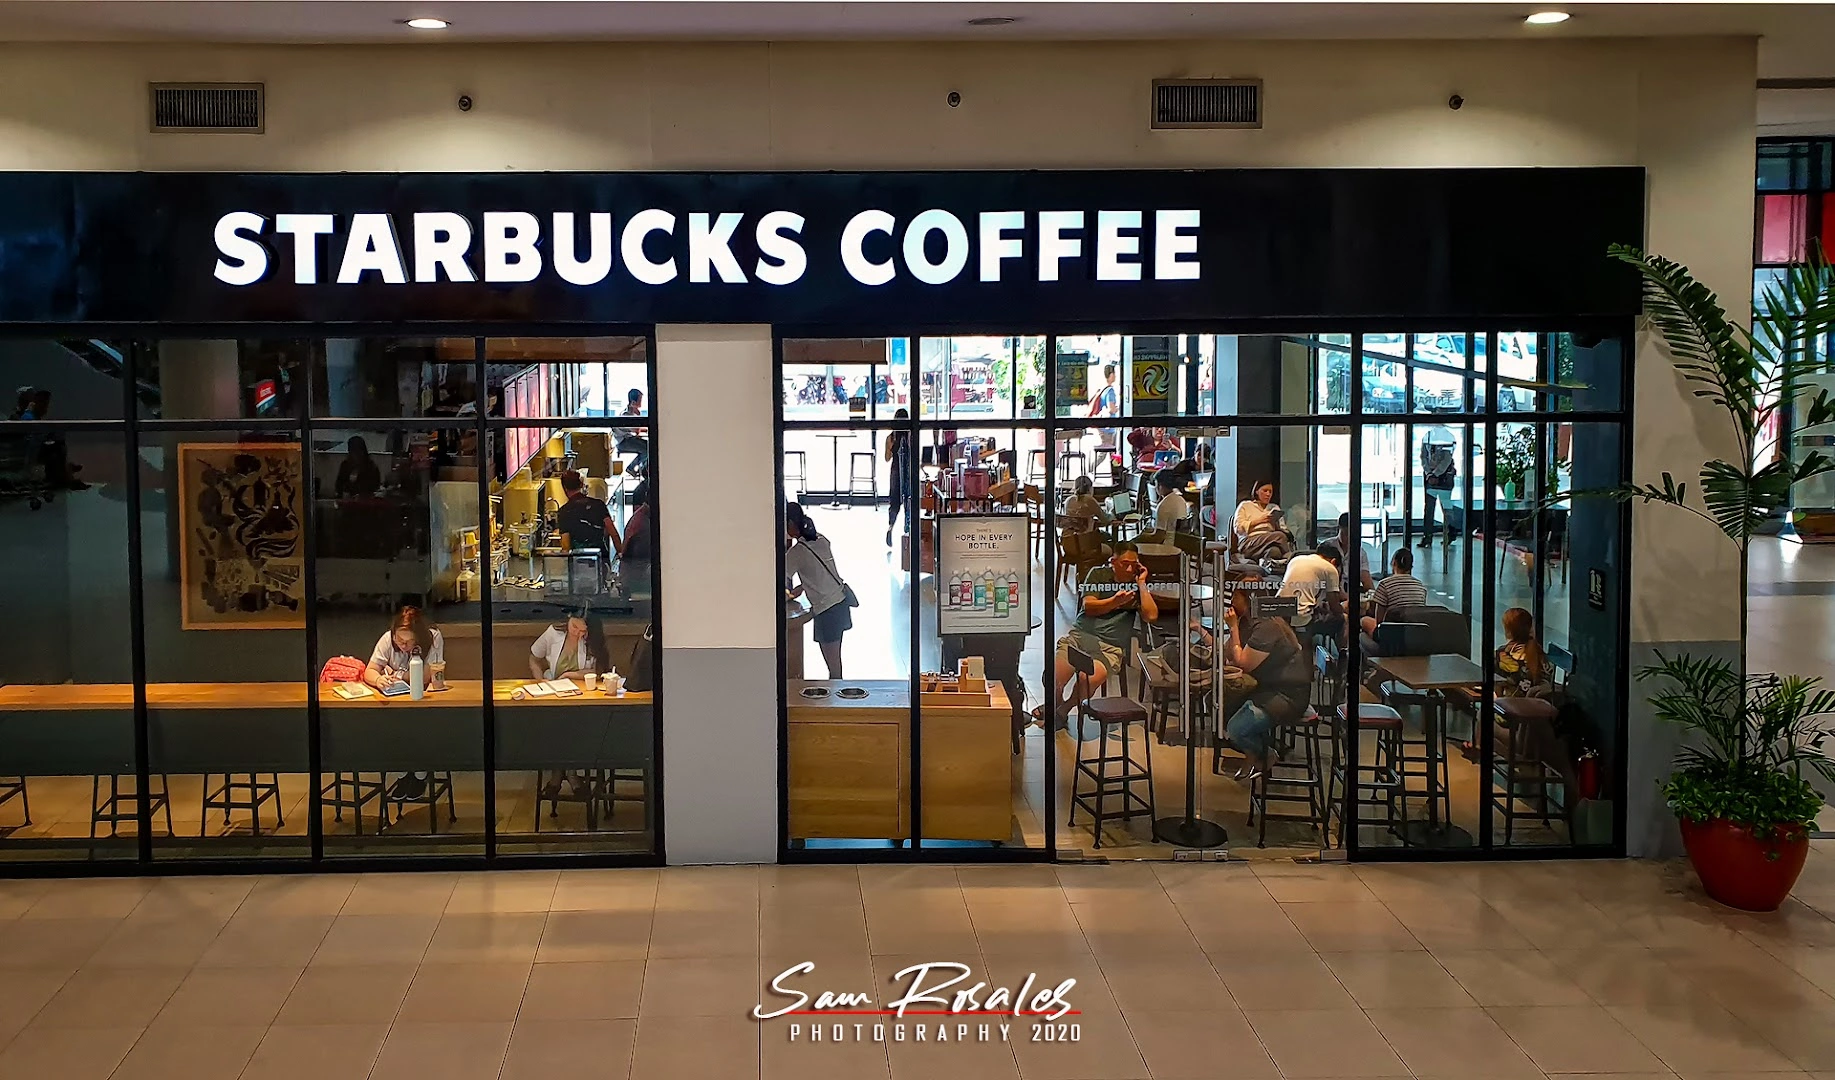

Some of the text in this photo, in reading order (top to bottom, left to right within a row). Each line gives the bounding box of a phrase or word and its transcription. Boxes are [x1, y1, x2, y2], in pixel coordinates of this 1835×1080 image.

[213, 208, 1201, 286] STARBUCKS COFFEE
[955, 533, 1013, 541] HOPE IN EVERY
[1078, 582, 1138, 592] STARBUCKS
[1224, 580, 1286, 590] STARBUCKS
